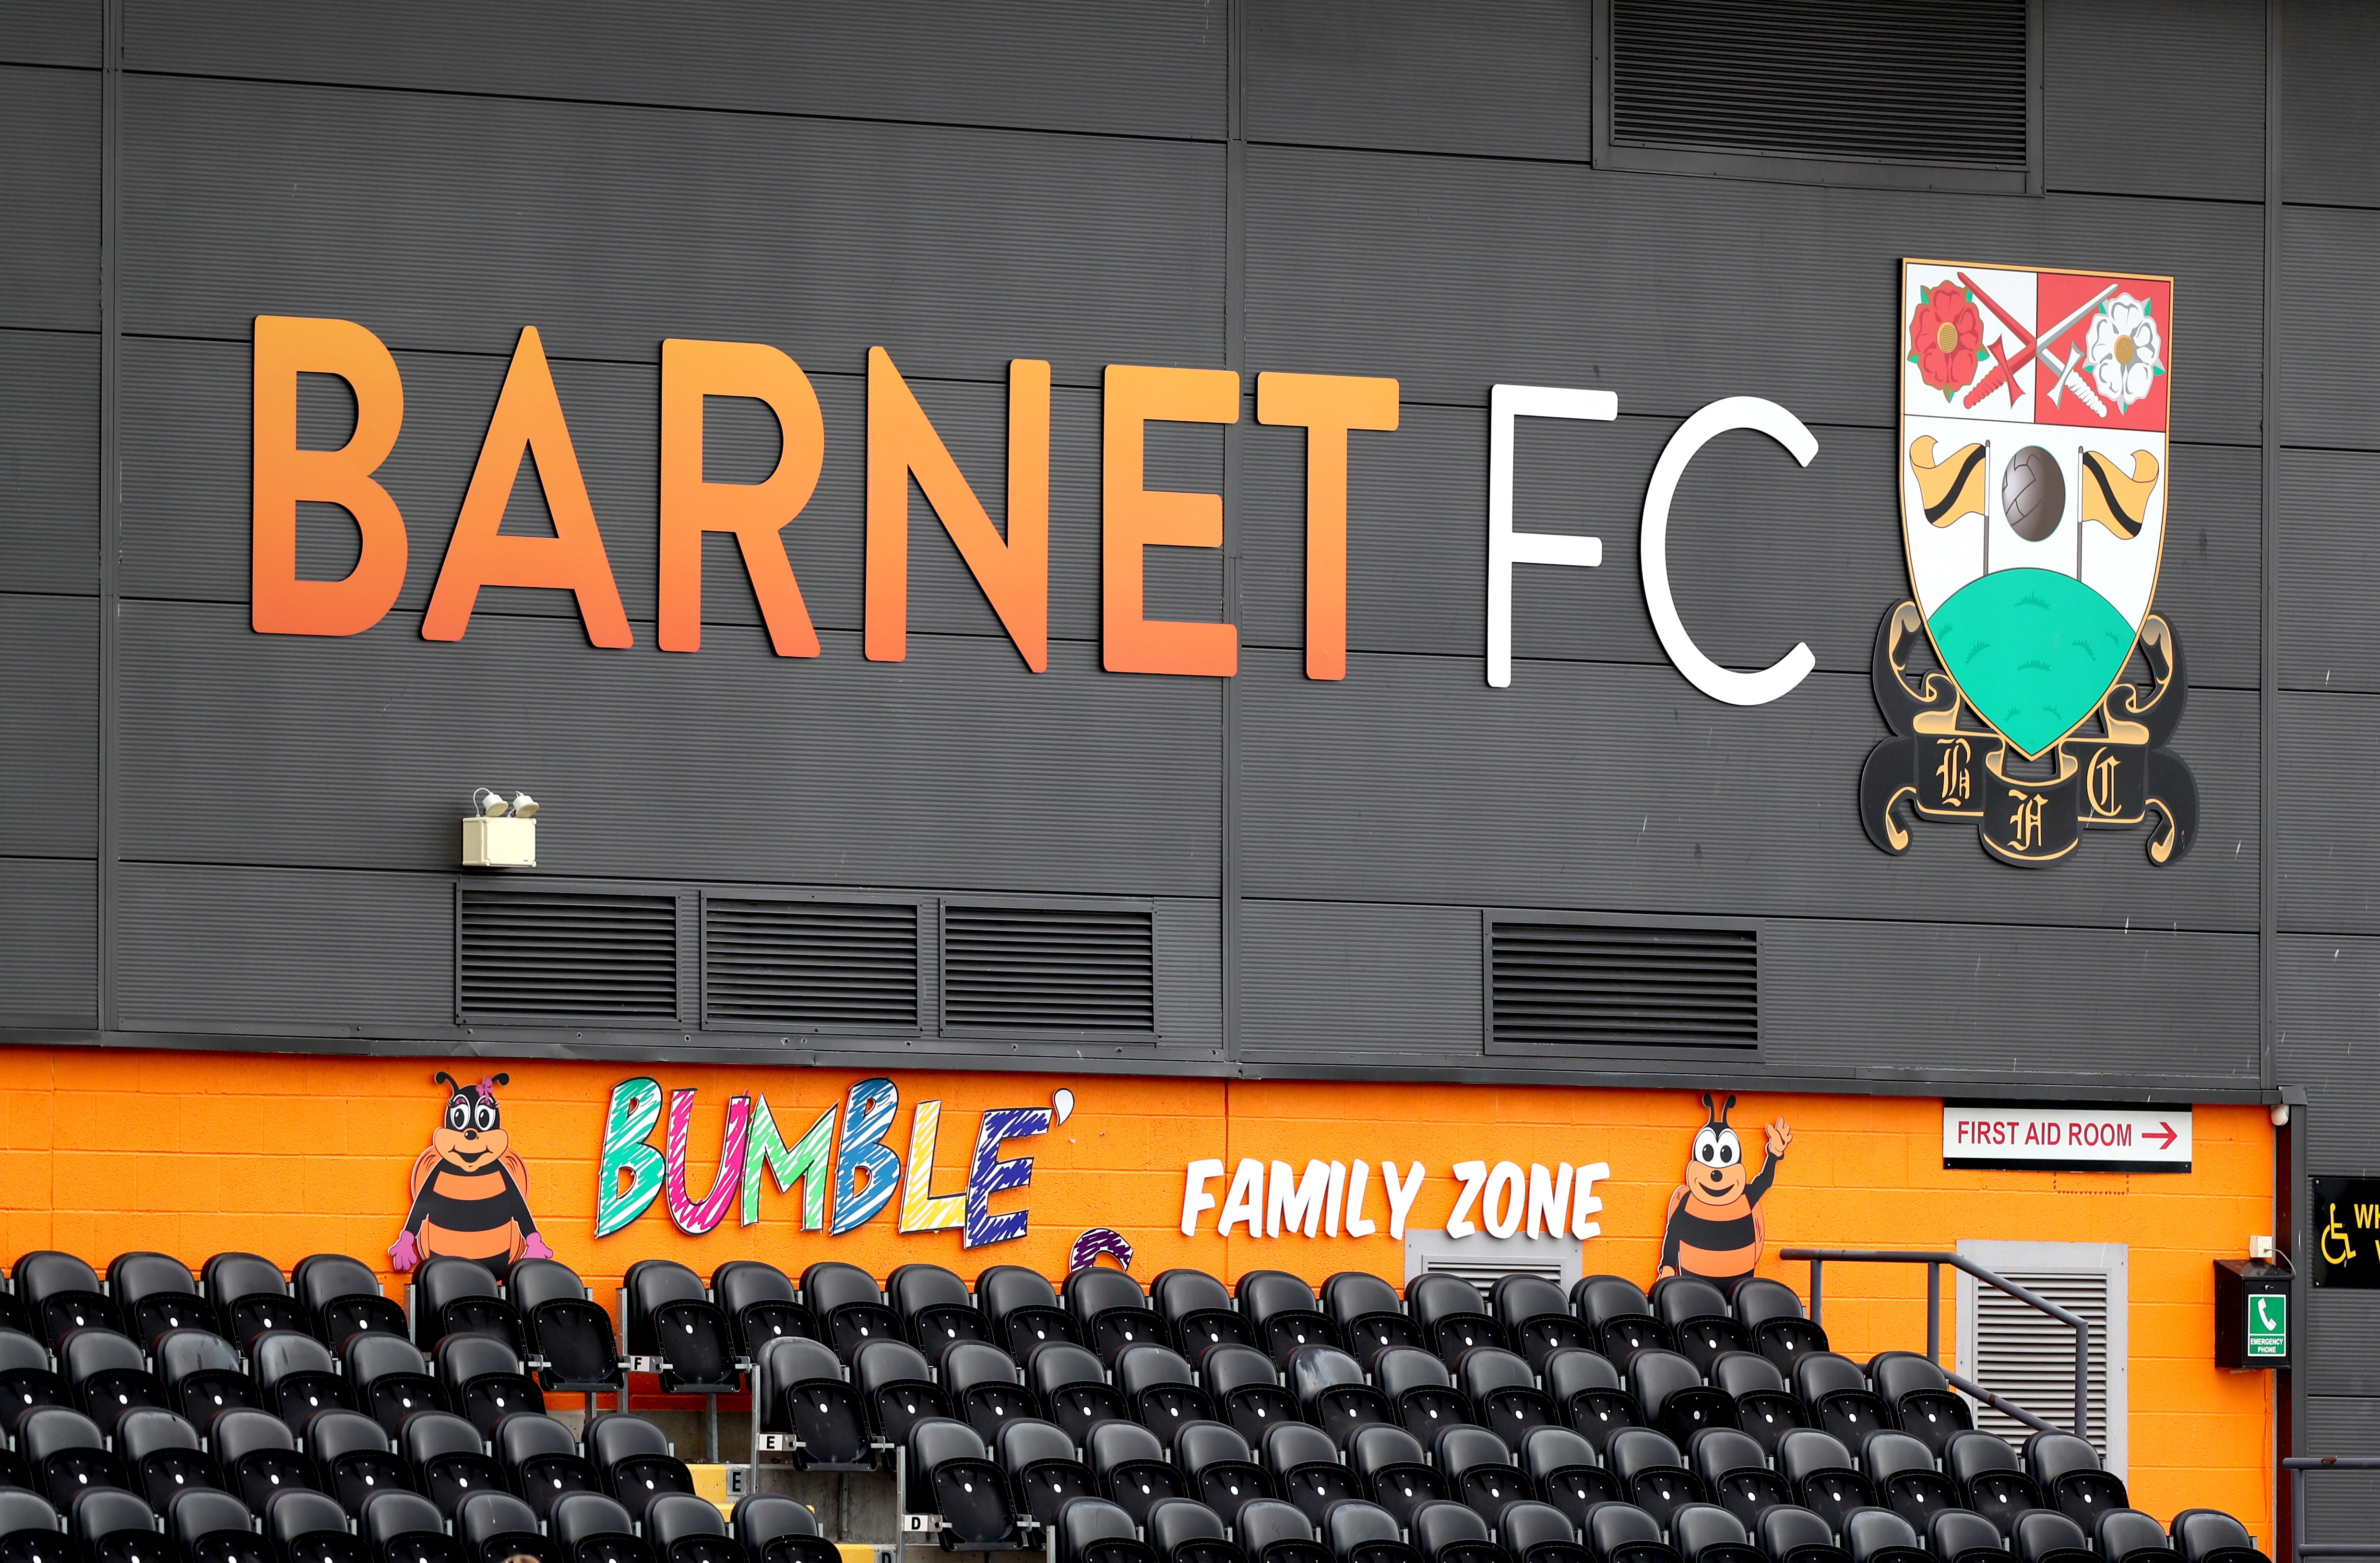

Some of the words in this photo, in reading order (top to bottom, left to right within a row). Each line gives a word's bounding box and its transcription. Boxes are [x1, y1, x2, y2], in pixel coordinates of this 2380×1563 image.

[251, 315, 1400, 681] BARNET
[1487, 384, 1819, 706] FC
[2086, 746, 2122, 817] C
[1958, 1121, 2019, 1145] FIRST
[2024, 1122, 2061, 1146] AID
[2068, 1123, 2132, 1147] ROOM
[595, 1075, 1075, 1249] BUMBLE'
[1181, 1158, 1426, 1241] FAMILY
[1446, 1160, 1610, 1240] ZONE
[634, 1357, 642, 1370] F
[766, 1436, 775, 1449] E
[732, 1472, 741, 1492] E
[912, 1517, 920, 1529] D
